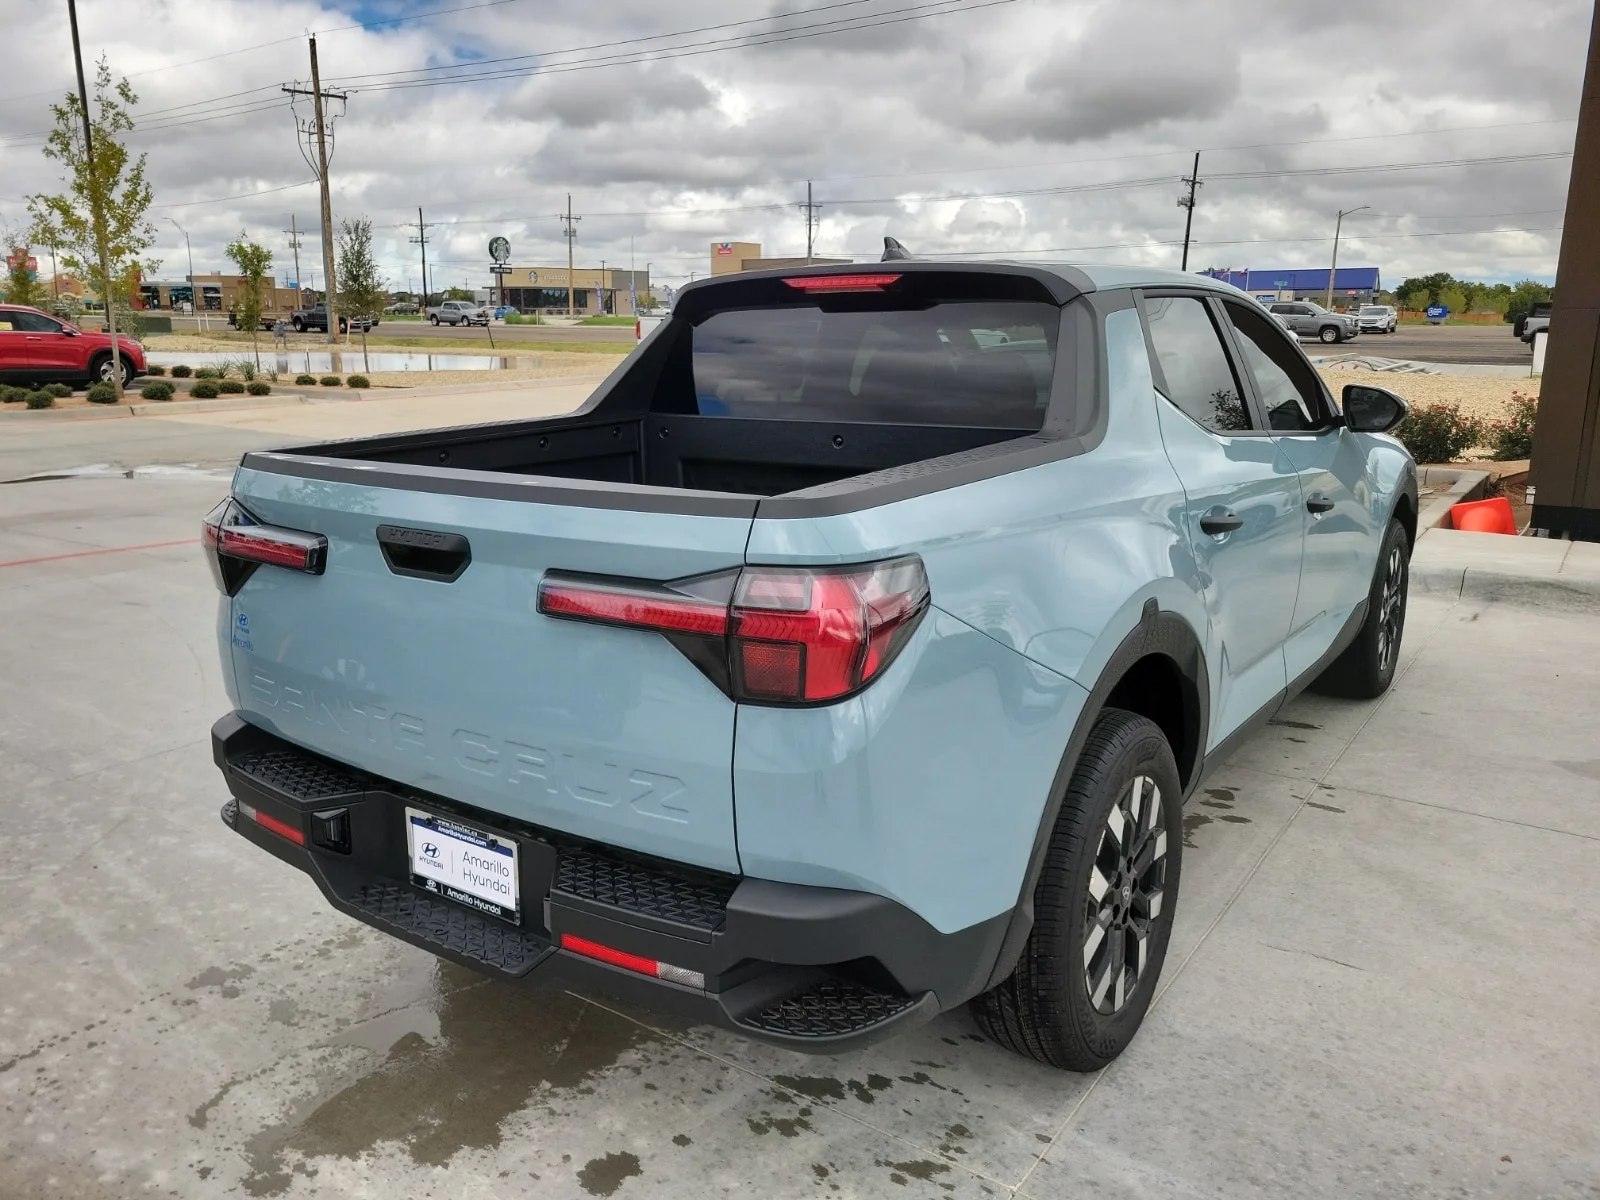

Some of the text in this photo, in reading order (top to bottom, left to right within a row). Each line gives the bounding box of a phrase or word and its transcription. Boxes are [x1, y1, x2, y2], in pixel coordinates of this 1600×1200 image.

[389, 527, 447, 547] HYUNDAI
[249, 666, 690, 824] SANTA CRUZ
[438, 826, 487, 847] AmarilloHyundai.com
[419, 856, 444, 870] HYUNDAI
[462, 851, 509, 877] Amarillo
[463, 868, 510, 896] Hyundai
[447, 888, 473, 905] Amarillo
[473, 897, 502, 916] Hyundai
